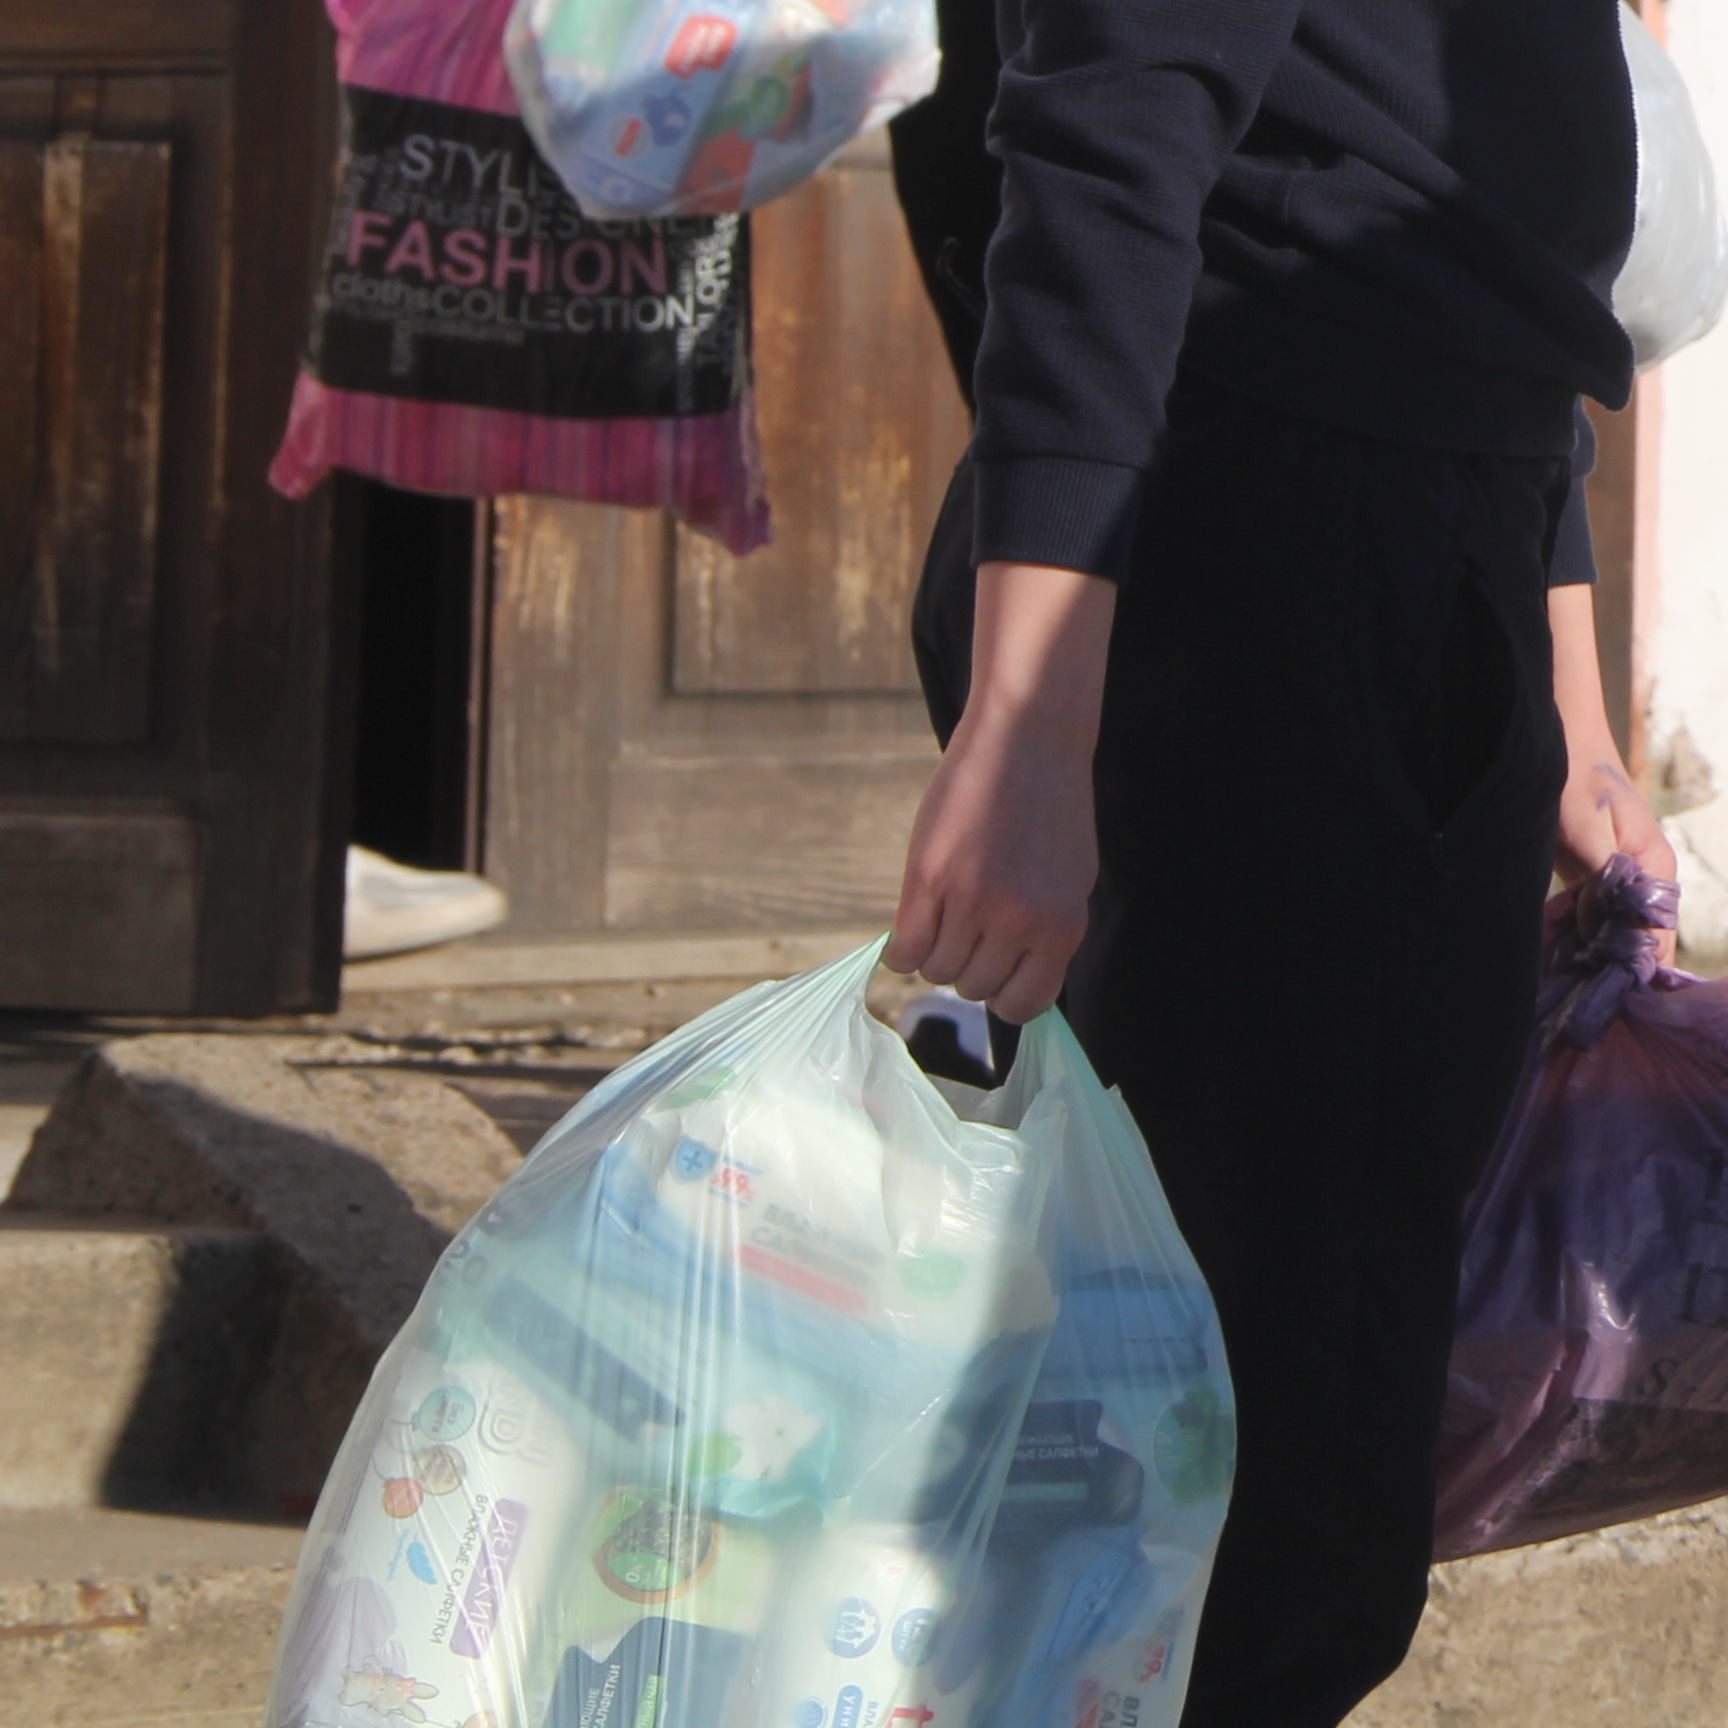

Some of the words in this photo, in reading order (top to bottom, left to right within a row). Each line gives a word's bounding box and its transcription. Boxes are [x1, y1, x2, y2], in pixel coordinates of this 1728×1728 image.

[346, 209, 668, 297] FASHION
[455, 1493, 490, 1567] ВЛАЖНЫЕ
[463, 1518, 519, 1642] ДЕТСКИЕ
